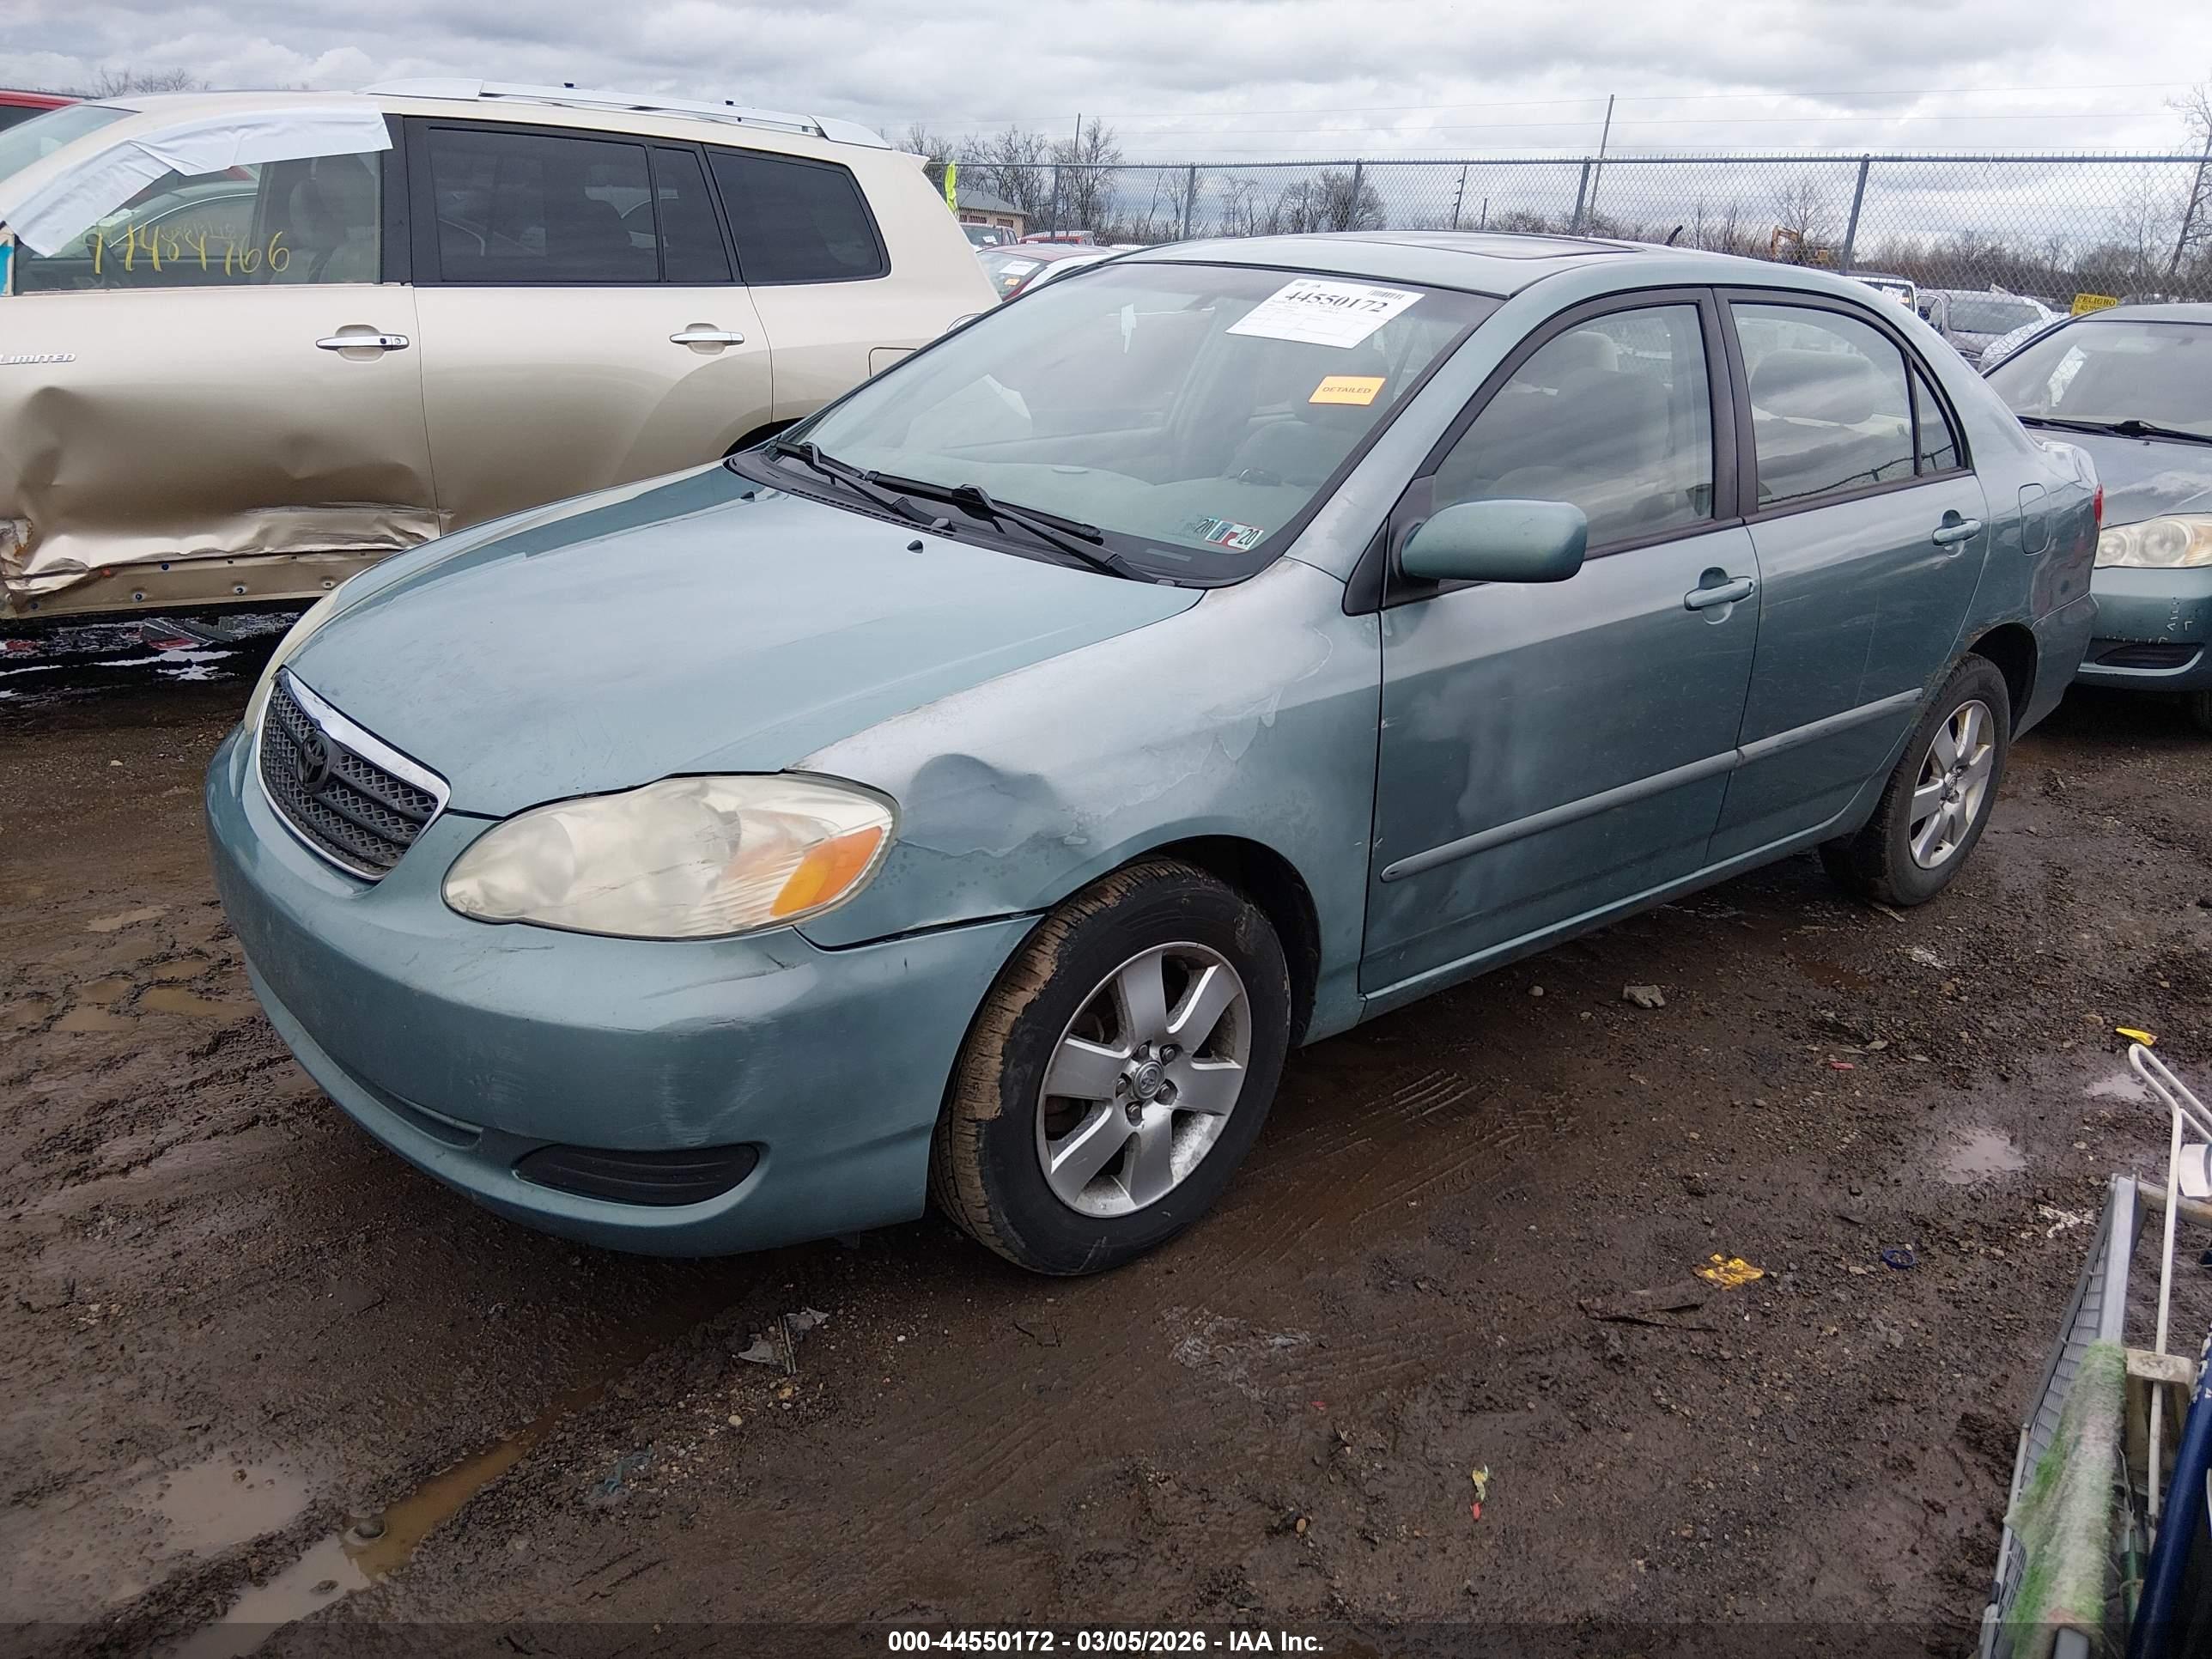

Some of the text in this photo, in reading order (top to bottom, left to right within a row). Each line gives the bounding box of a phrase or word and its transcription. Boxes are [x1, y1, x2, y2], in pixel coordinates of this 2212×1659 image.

[1285, 290, 1389, 313] 44550172
[0, 353, 76, 365] LIMITED
[1322, 386, 1372, 394] DETAILED
[1237, 529, 1260, 545] 20
